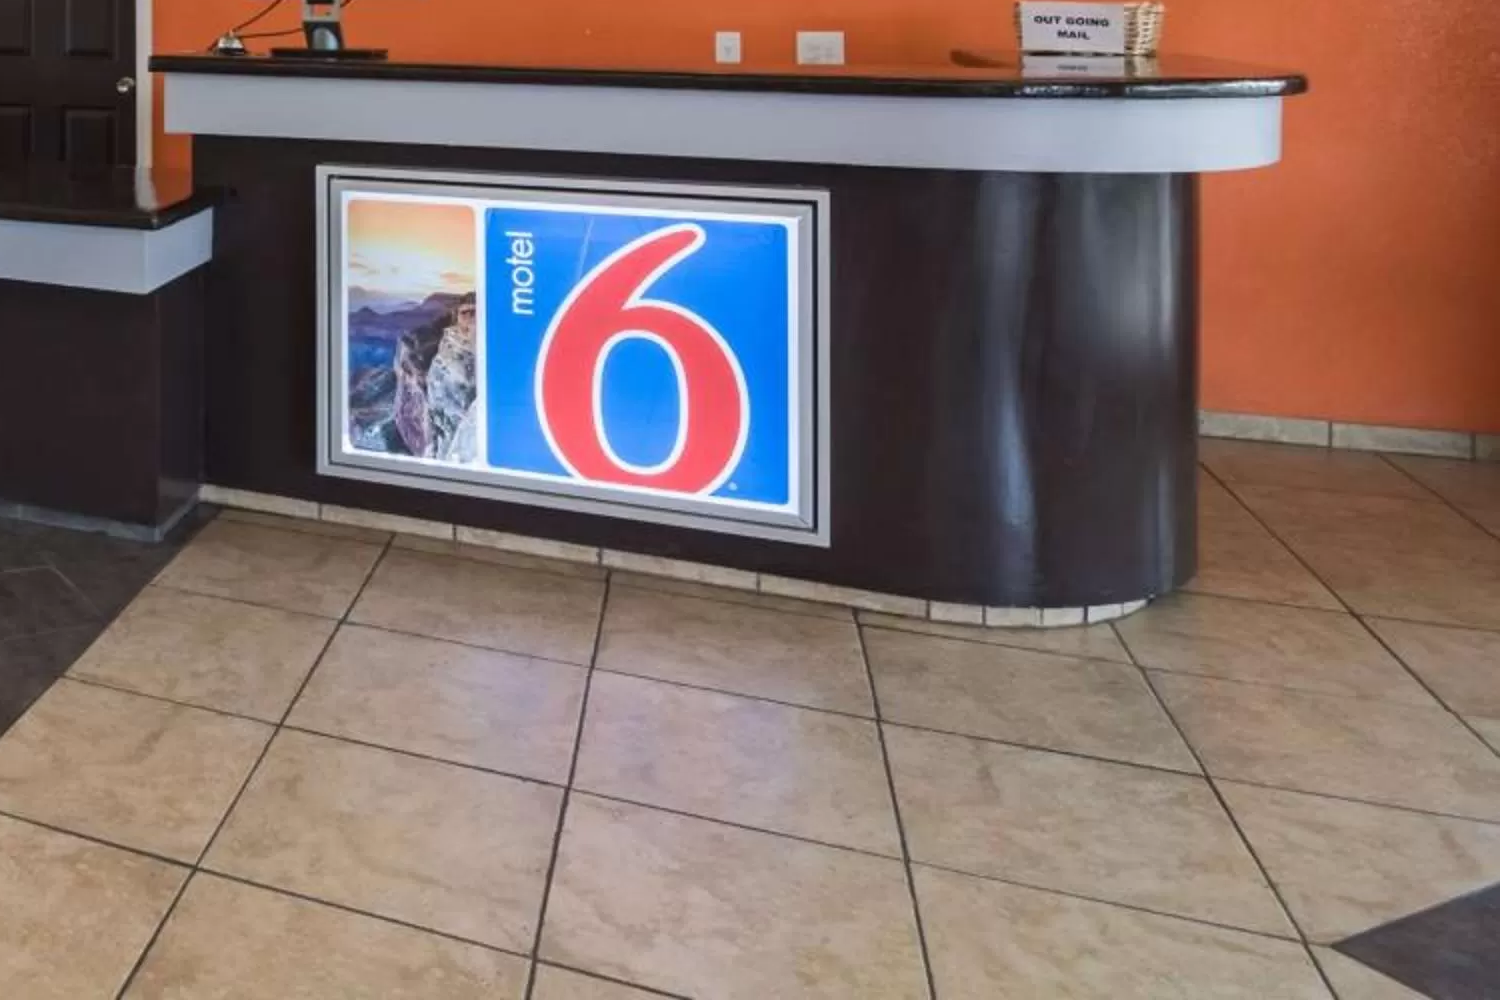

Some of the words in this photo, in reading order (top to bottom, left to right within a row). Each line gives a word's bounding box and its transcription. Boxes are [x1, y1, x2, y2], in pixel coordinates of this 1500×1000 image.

[1033, 15, 1062, 25] OUT
[1065, 16, 1110, 27] GOING
[1057, 30, 1091, 40] MAIL
[504, 230, 535, 316] motel
[536, 222, 751, 498] 6
